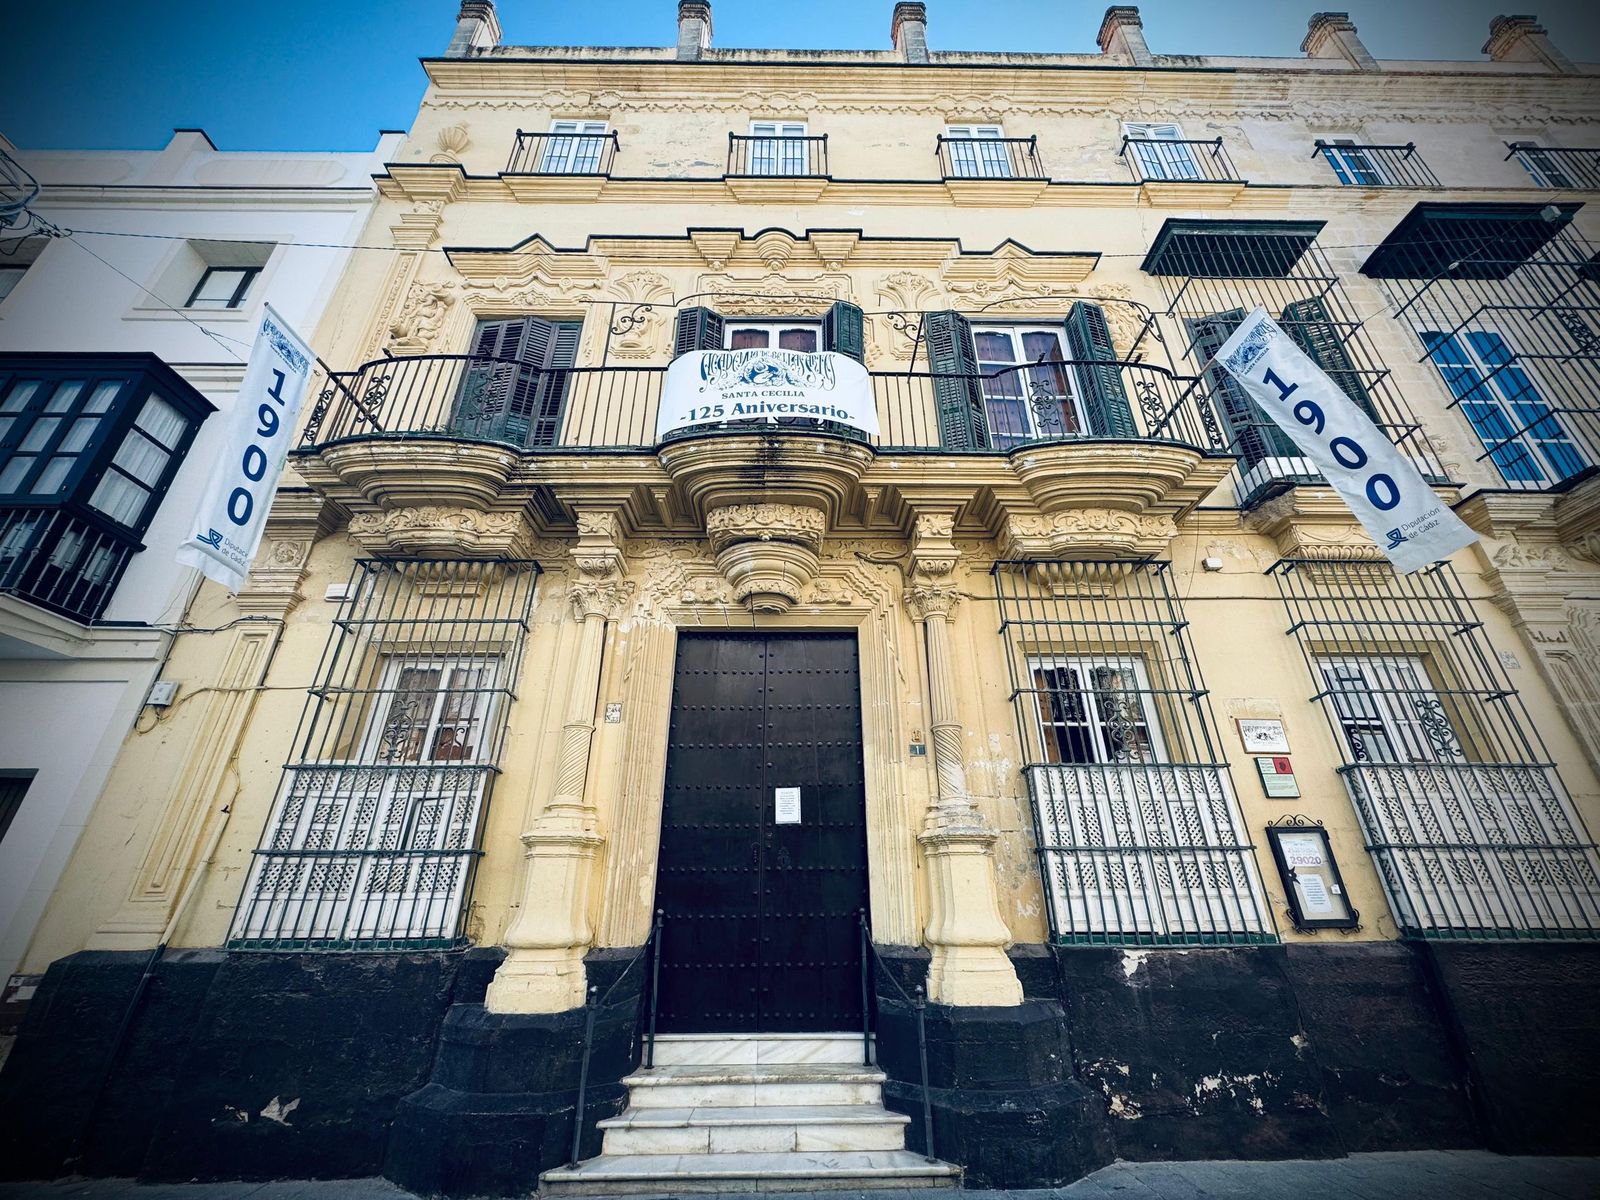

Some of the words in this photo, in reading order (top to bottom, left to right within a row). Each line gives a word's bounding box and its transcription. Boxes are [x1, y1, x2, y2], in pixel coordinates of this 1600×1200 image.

[721, 391, 759, 400] SANTA
[761, 390, 806, 398] CECILIA
[680, 404, 725, 421] -125
[731, 400, 856, 421] Aniversario-
[227, 368, 286, 527] 1900
[1262, 367, 1401, 511] 1900
[1400, 506, 1441, 532] Diputación
[1408, 530, 1419, 540] de
[1418, 518, 1441, 536] Cádiz
